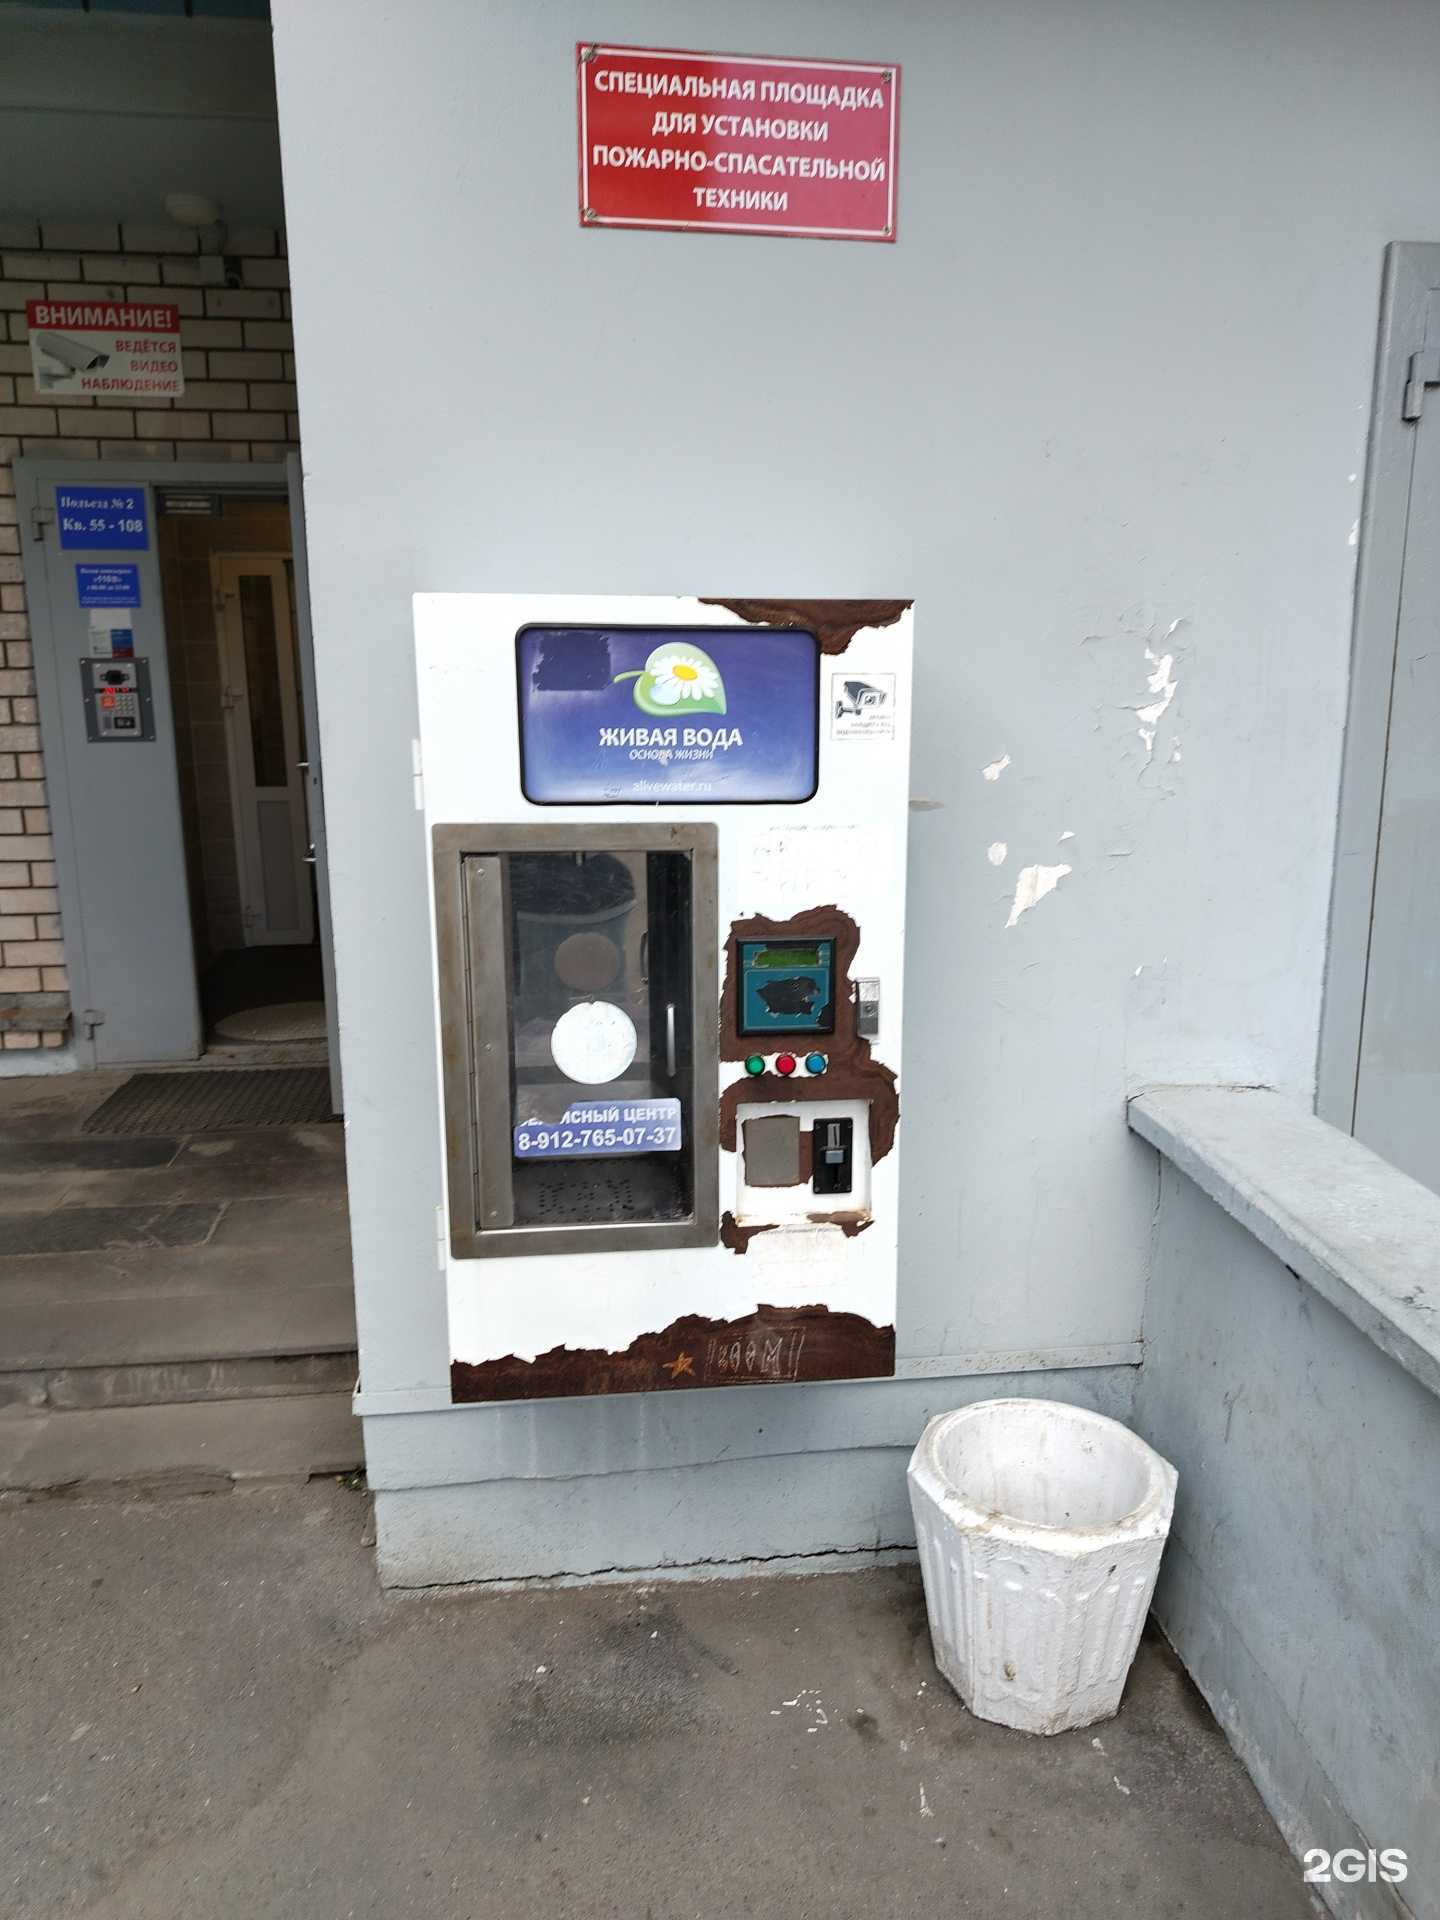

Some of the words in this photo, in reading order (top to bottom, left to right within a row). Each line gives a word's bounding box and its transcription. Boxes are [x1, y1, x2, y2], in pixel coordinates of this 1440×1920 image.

[594, 70, 756, 101] СПЕЦИАЛЬНАЯ
[760, 82, 884, 112] ПЛОЩАДКА
[652, 111, 697, 137] ДЛЯ
[701, 114, 828, 142] УСТАНОВКИ
[592, 144, 886, 182] ПОЖАРНО-СПАСАТЕЛЬНОЙ
[693, 186, 788, 212] ТЕХНИКИ
[35, 305, 172, 328] ВНИМАНИЕ!
[115, 338, 176, 354] ВЕДЁТСЯ
[129, 360, 177, 374] ВИДЕО
[81, 377, 179, 393] НАБЛЮДЕНИЕ
[126, 498, 135, 510] 2
[63, 518, 87, 531] Кв.
[89, 518, 105, 532] 55
[118, 519, 144, 532] 108
[599, 728, 677, 746] ЖИВАЯ
[683, 728, 743, 751] ВОДА
[623, 1107, 677, 1123] ЦЕНТР
[518, 1126, 677, 1151] 8-912-765-07-37
